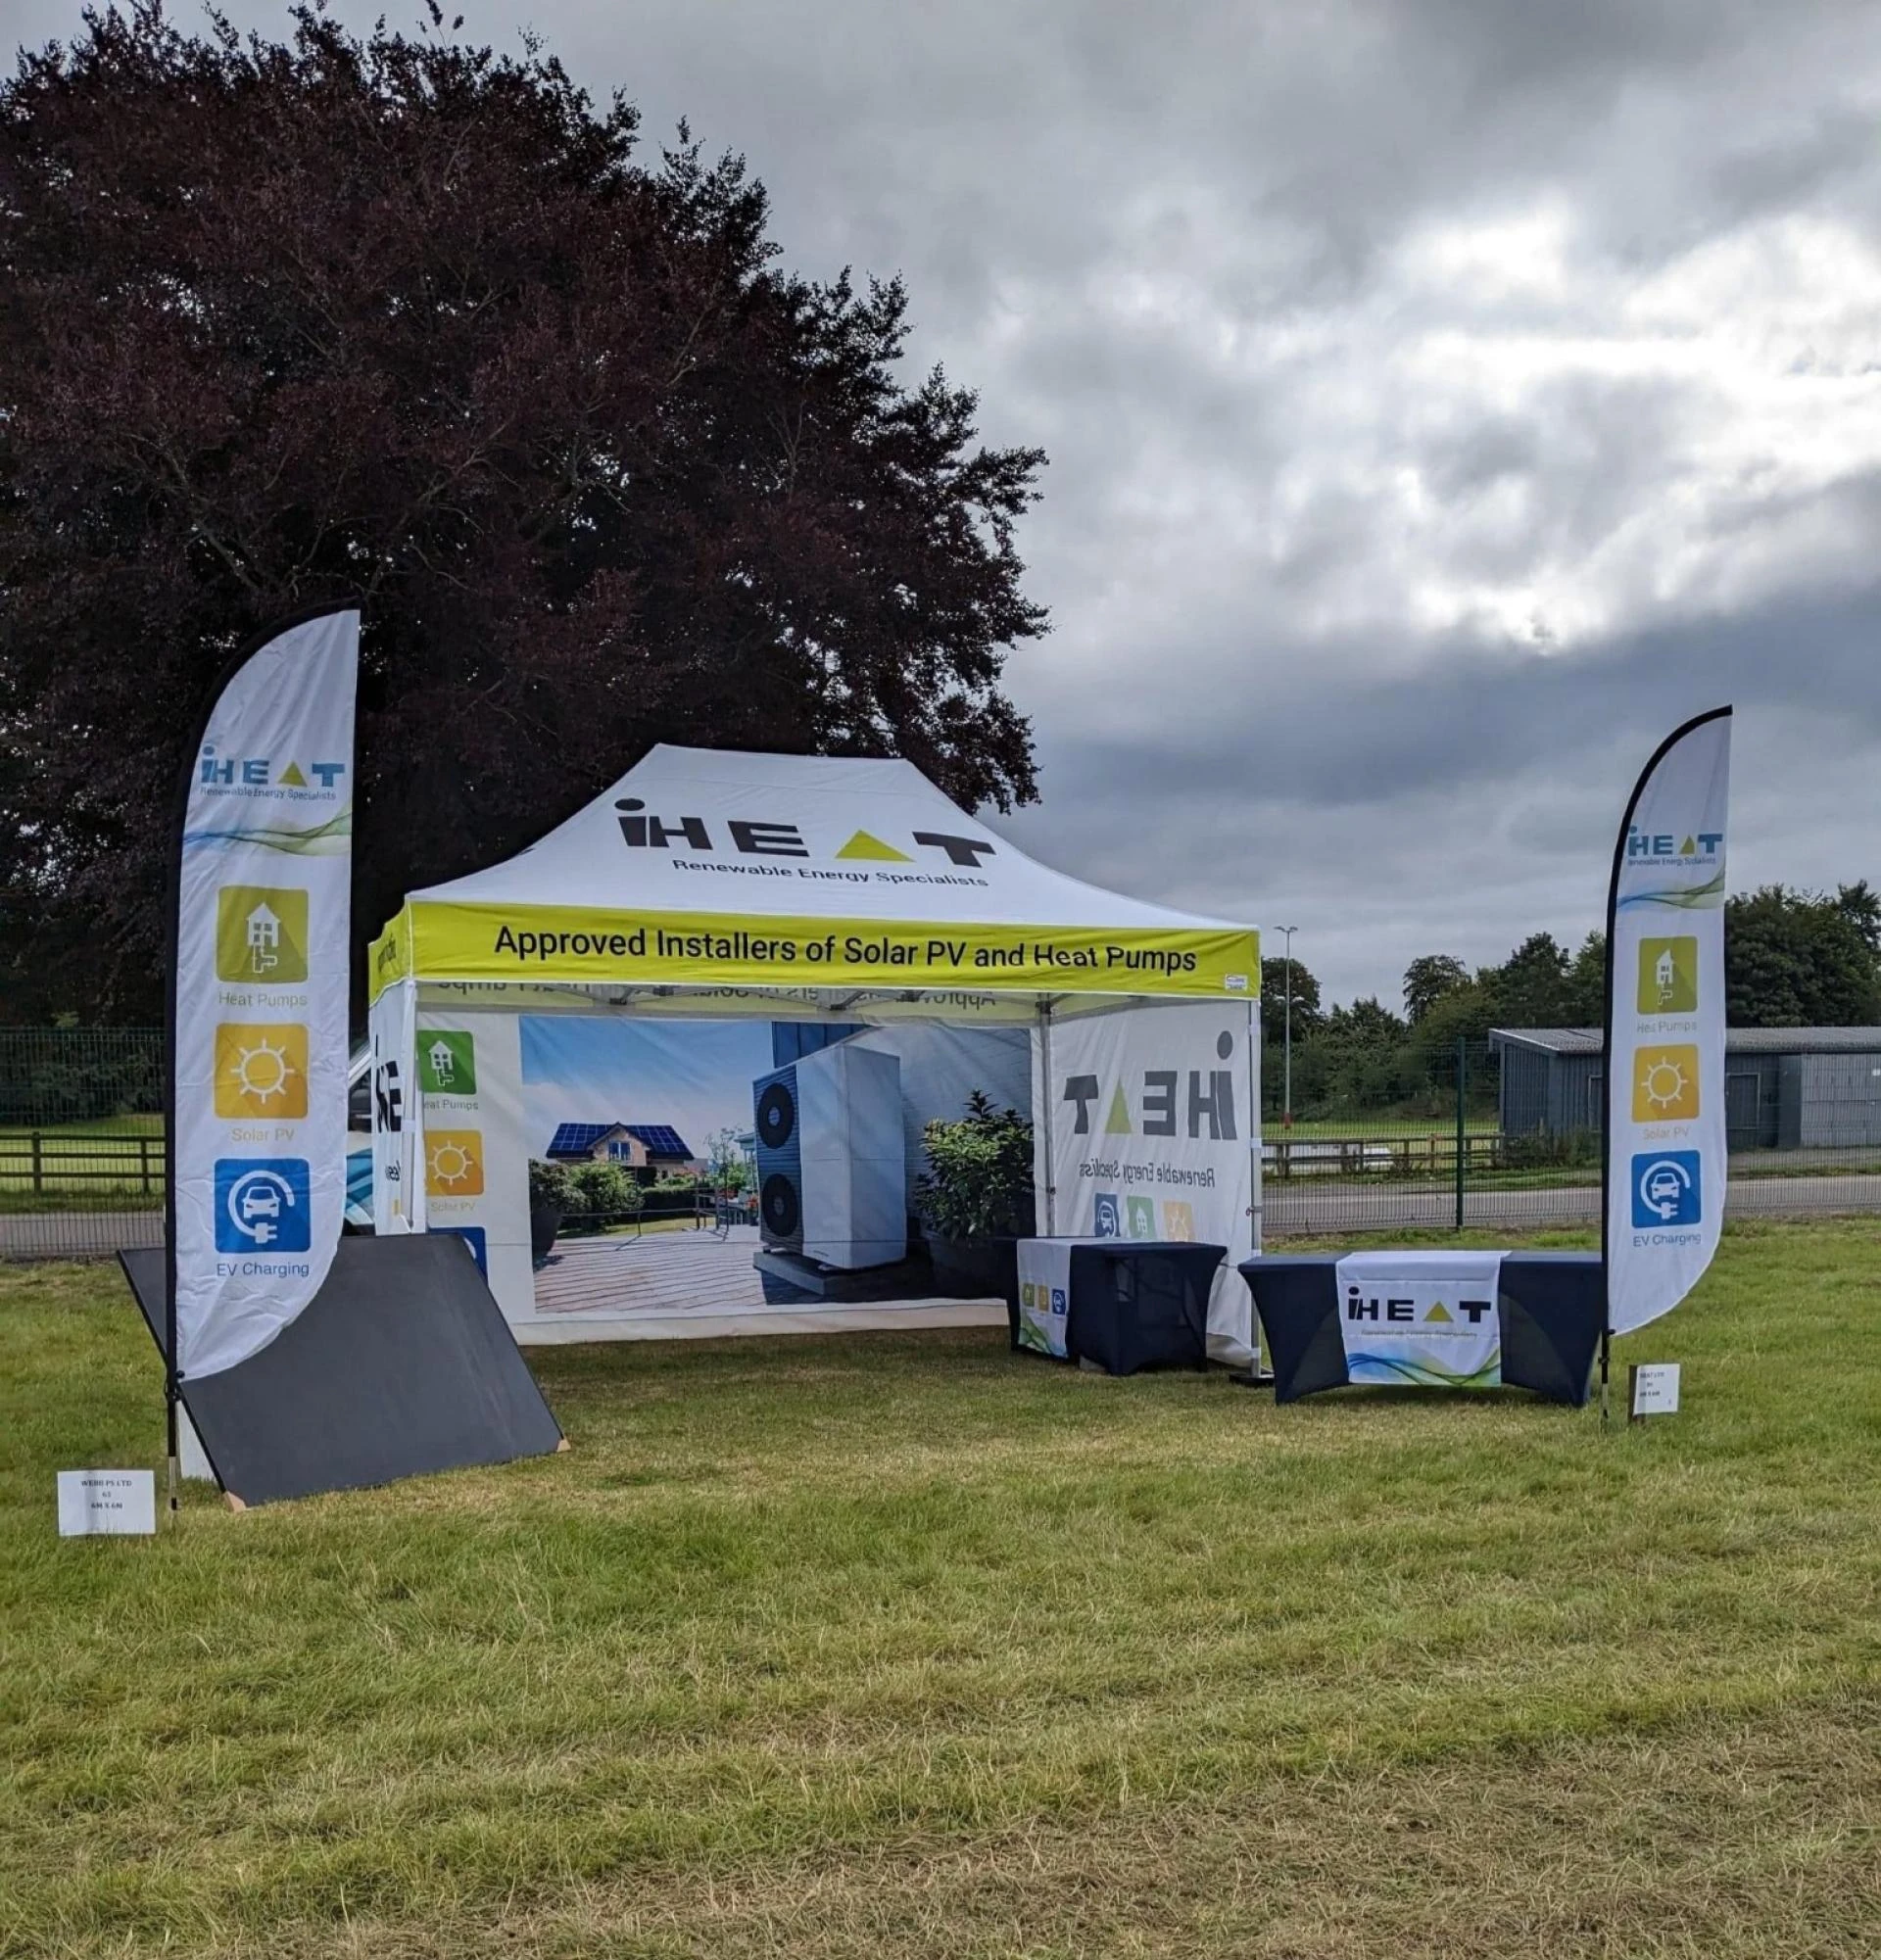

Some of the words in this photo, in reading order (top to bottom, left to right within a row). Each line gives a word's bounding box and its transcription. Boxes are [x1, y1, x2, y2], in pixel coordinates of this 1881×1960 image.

[253, 788, 285, 799] Energy
[672, 858, 794, 878] Renewable
[799, 868, 869, 883] Energy
[876, 872, 989, 886] Specialists
[495, 926, 647, 961] Approved
[657, 929, 797, 962] Installers
[806, 934, 836, 962] of
[844, 937, 919, 966] Solar
[927, 940, 967, 967] PV
[975, 943, 1025, 968] and
[1034, 944, 1099, 970] Heat
[1107, 946, 1197, 977] Pumps
[218, 991, 253, 1006] Heat
[258, 992, 309, 1009] Pumps
[443, 1098, 479, 1112] Pumps
[231, 1127, 269, 1142] Solar
[274, 1127, 295, 1142] PV
[1632, 1234, 1650, 1247] EV
[216, 1263, 238, 1277] EV
[241, 1261, 310, 1278] Charging
